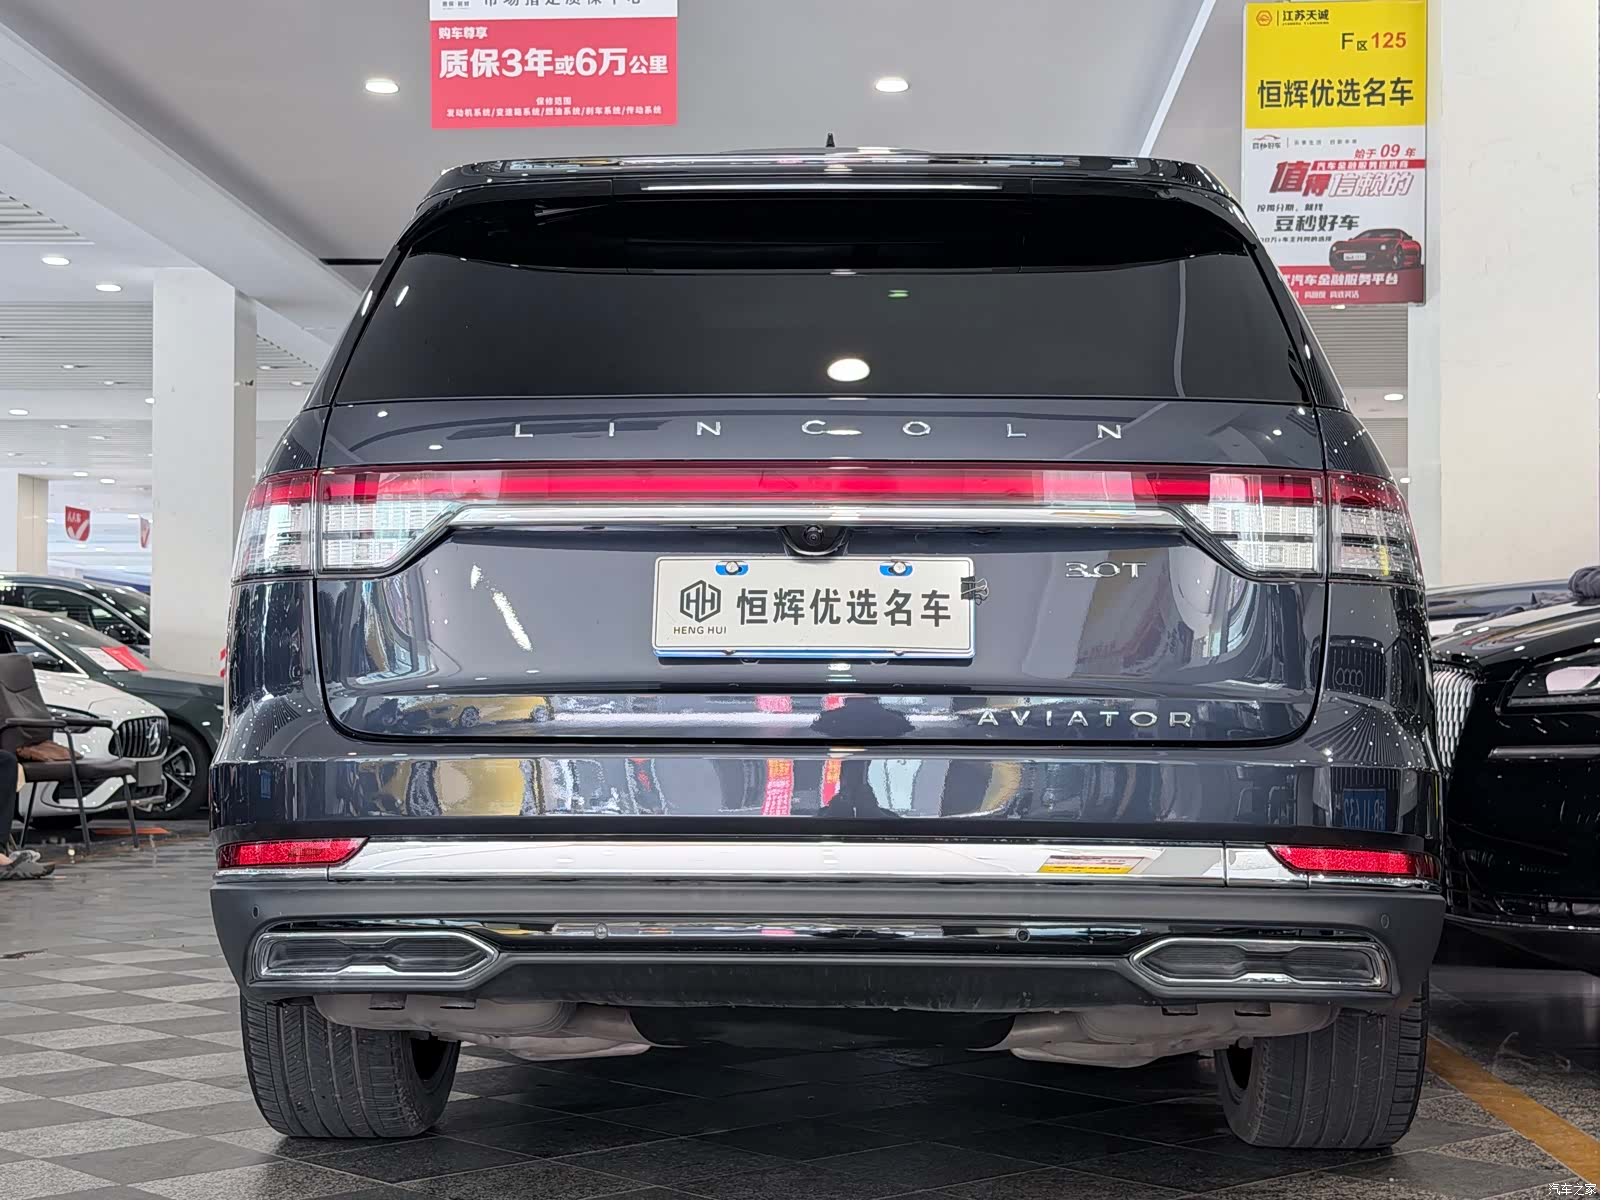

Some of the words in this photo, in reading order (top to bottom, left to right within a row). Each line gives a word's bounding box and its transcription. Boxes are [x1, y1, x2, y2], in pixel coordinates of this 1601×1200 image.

[1282, 9, 1329, 21] 江苏天诚
[438, 26, 488, 40] 购车尊享
[439, 47, 669, 79] 质保3年或6万公里
[535, 96, 572, 106] 保修范围
[1257, 77, 1414, 109] 恒辉优选名车
[1274, 215, 1360, 232] 豆秒好车
[513, 419, 1123, 440] LINCOLN
[736, 587, 952, 627] 恒辉优选名车
[673, 625, 704, 635] HENG
[707, 625, 727, 635] HUI
[977, 710, 1192, 728] AVIATOR
